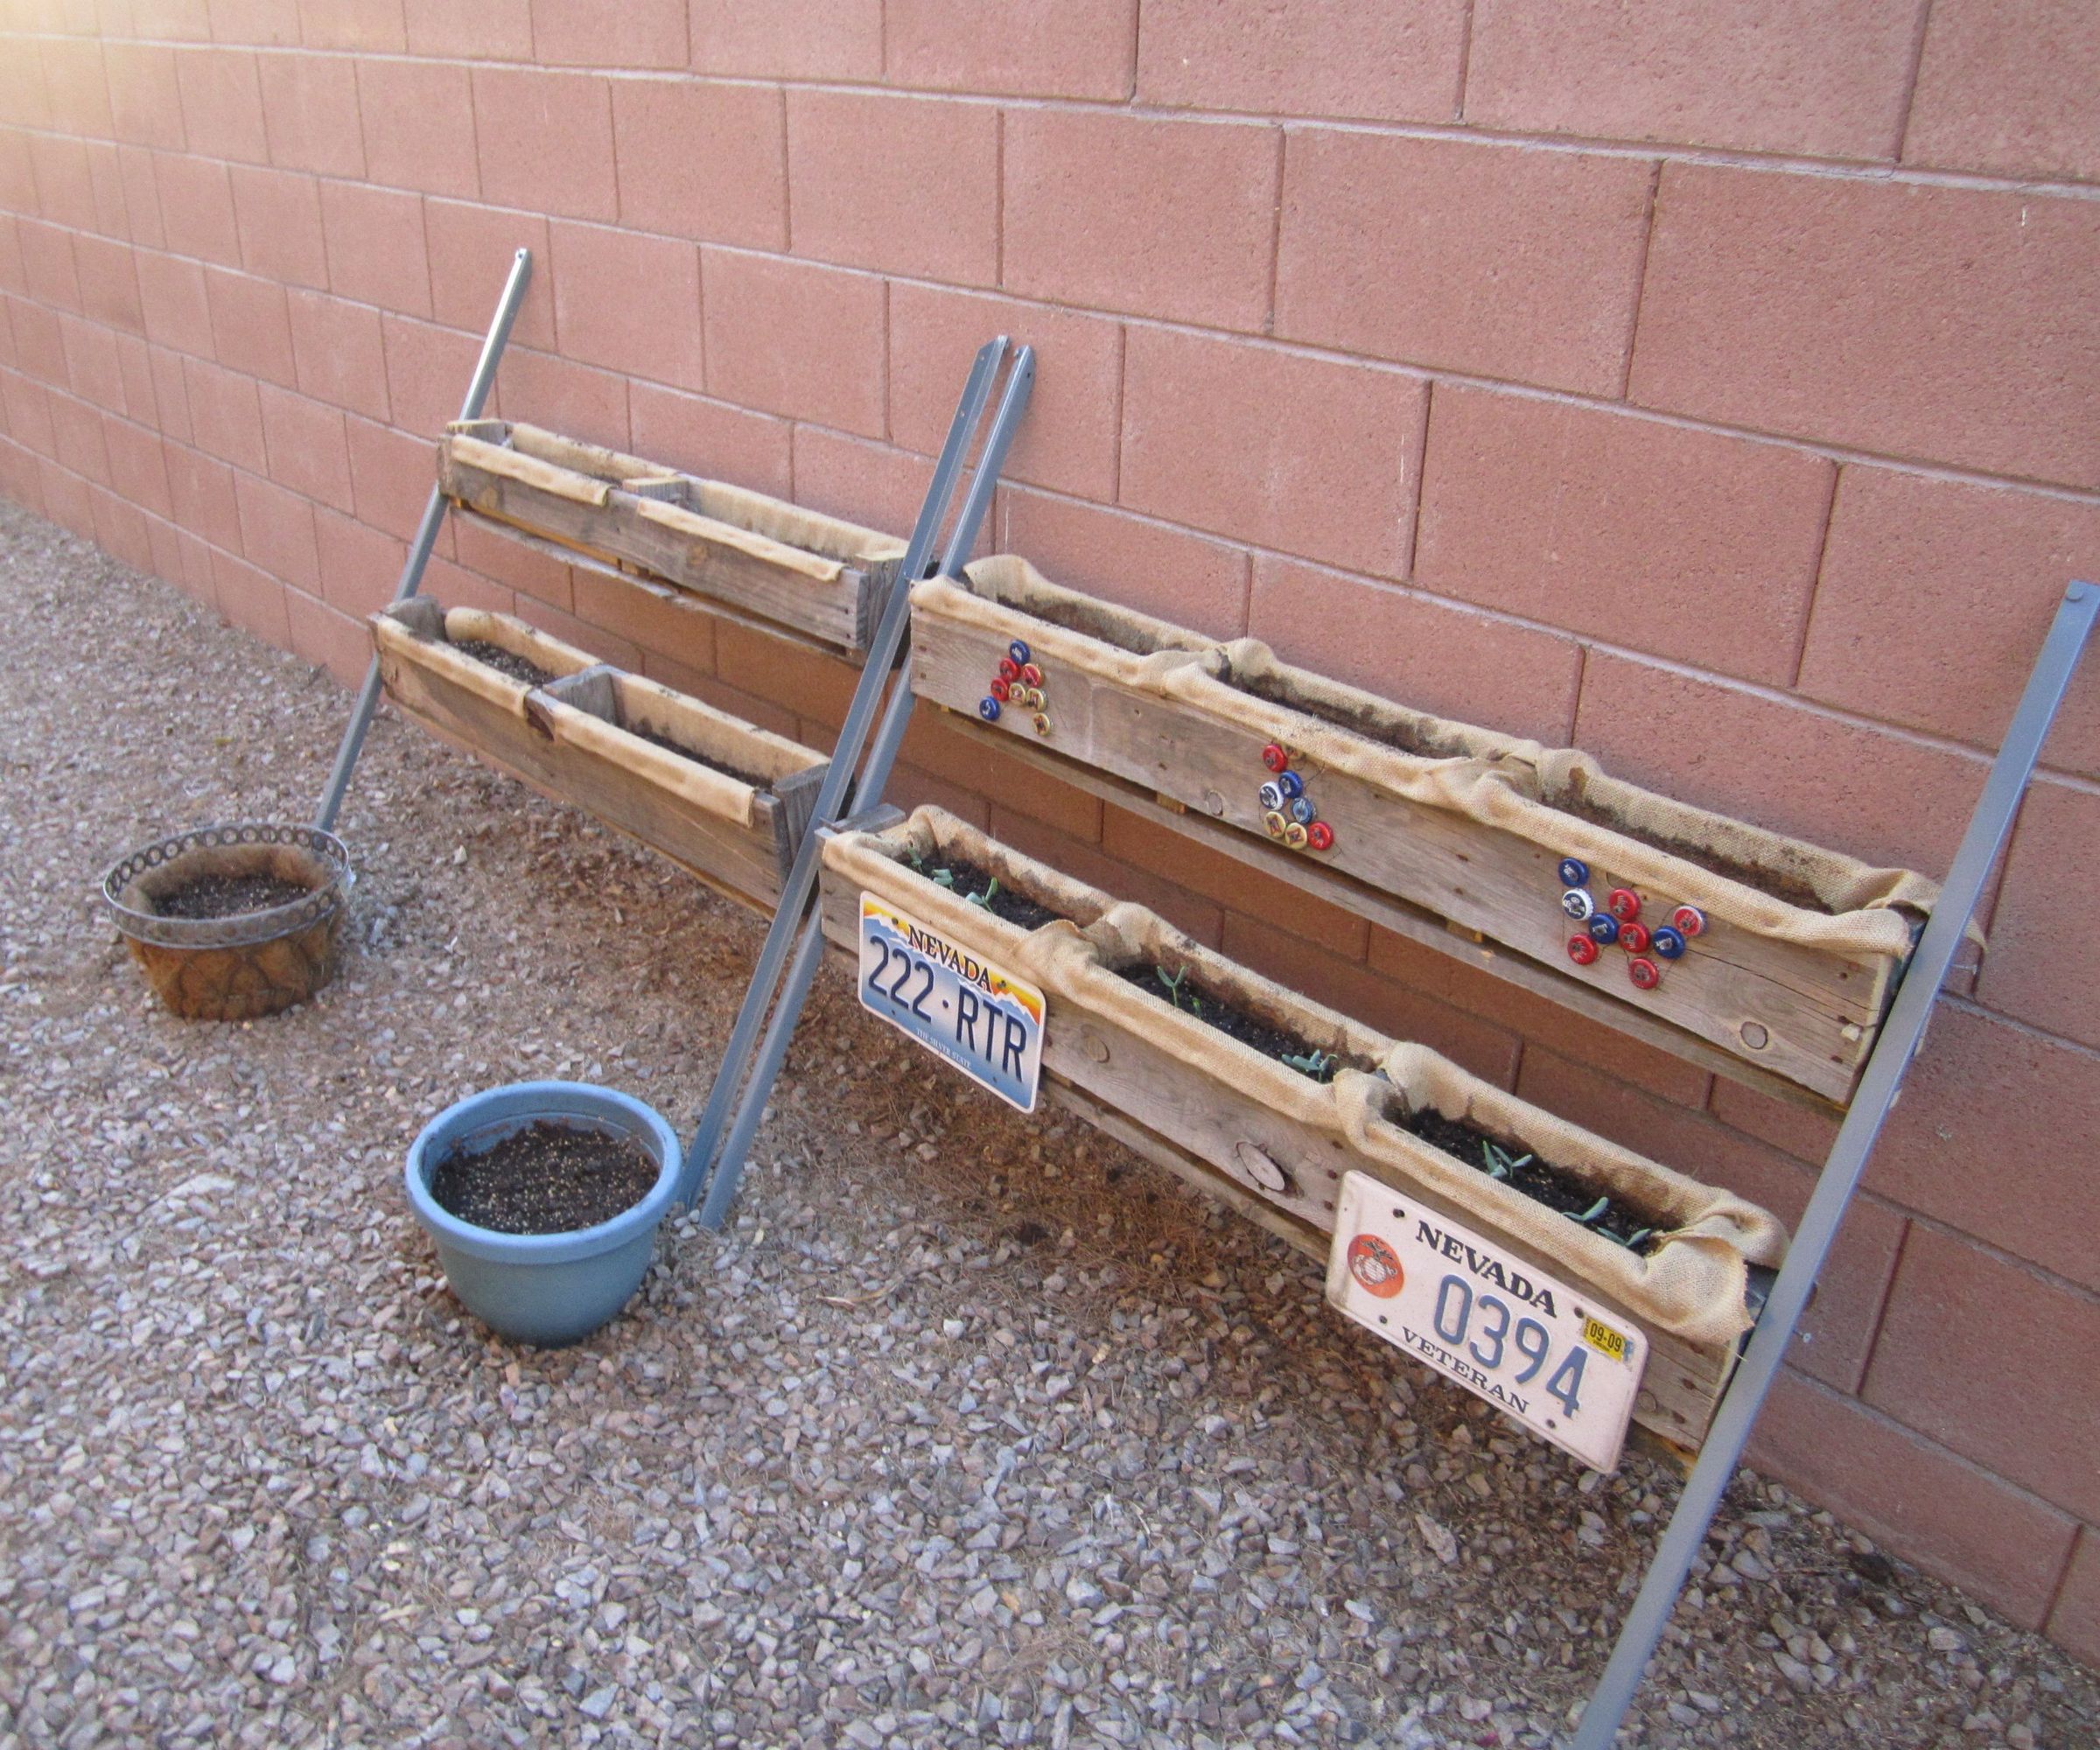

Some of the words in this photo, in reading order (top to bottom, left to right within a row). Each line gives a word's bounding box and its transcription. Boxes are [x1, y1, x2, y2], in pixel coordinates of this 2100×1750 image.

[907, 924, 992, 994] NEVADA
[1415, 1220, 1558, 1319] NEVADA
[1402, 1326, 1530, 1414] VETERAN
[1433, 1273, 1588, 1419] 0394
[1590, 1322, 1622, 1352] 09-09
